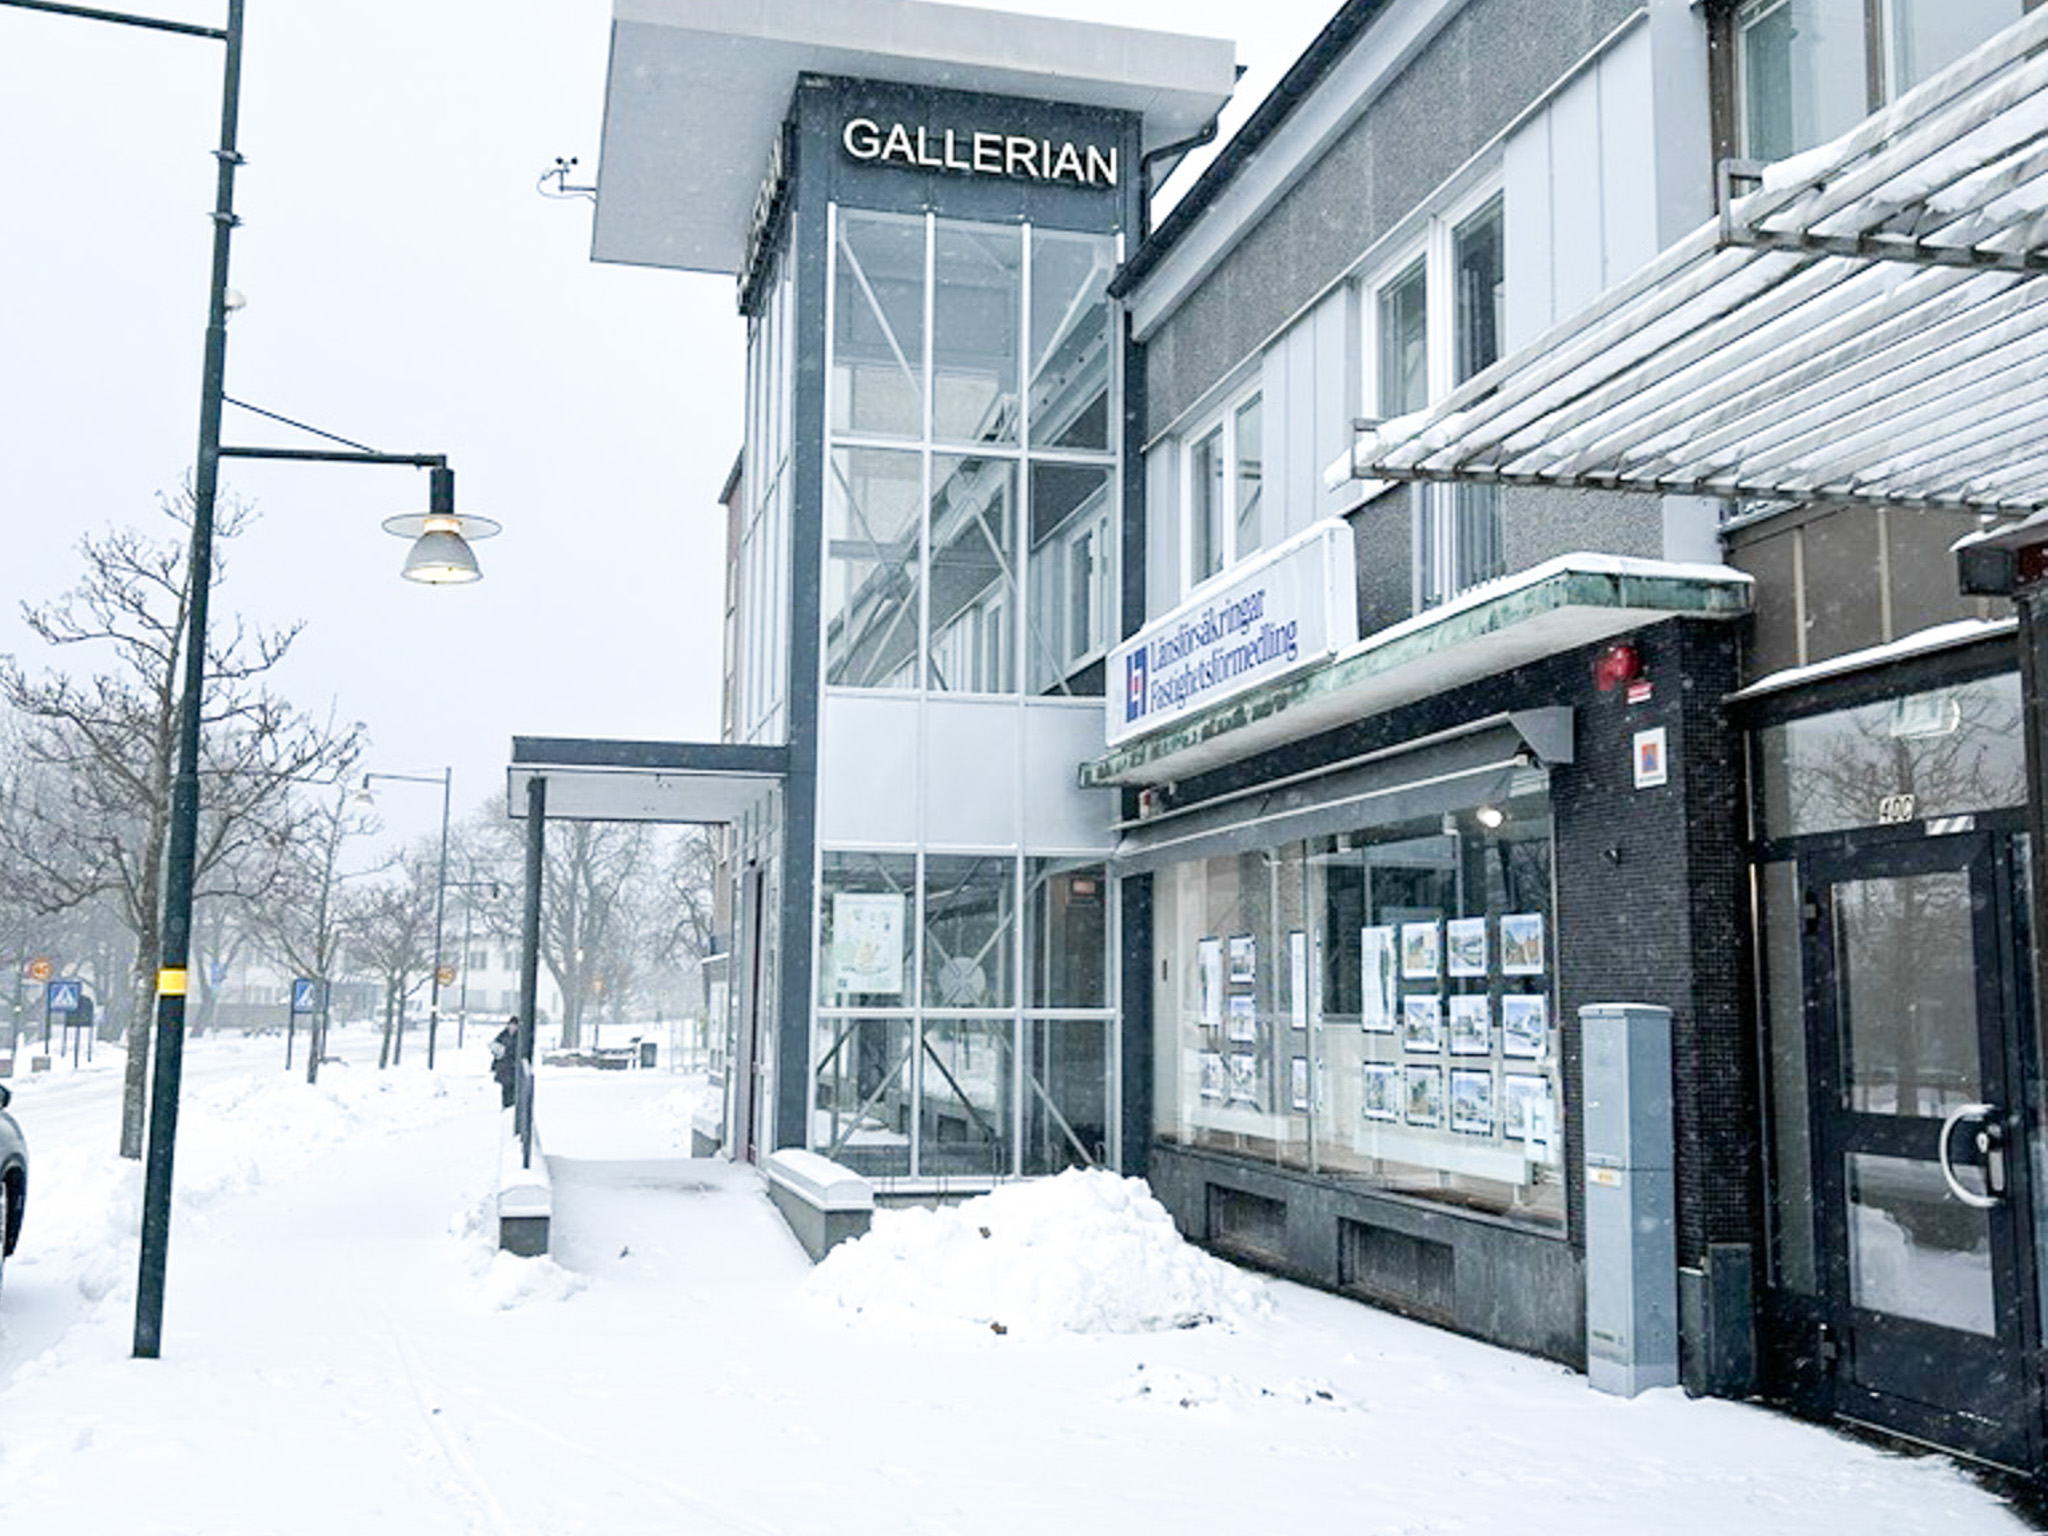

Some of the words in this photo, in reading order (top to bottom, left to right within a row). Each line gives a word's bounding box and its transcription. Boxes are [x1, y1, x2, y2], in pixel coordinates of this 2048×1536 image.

[842, 118, 1118, 185] GALLERIAN
[1150, 588, 1266, 673] Länsförsäkringar
[1150, 620, 1298, 713] Fastighetsförmedling
